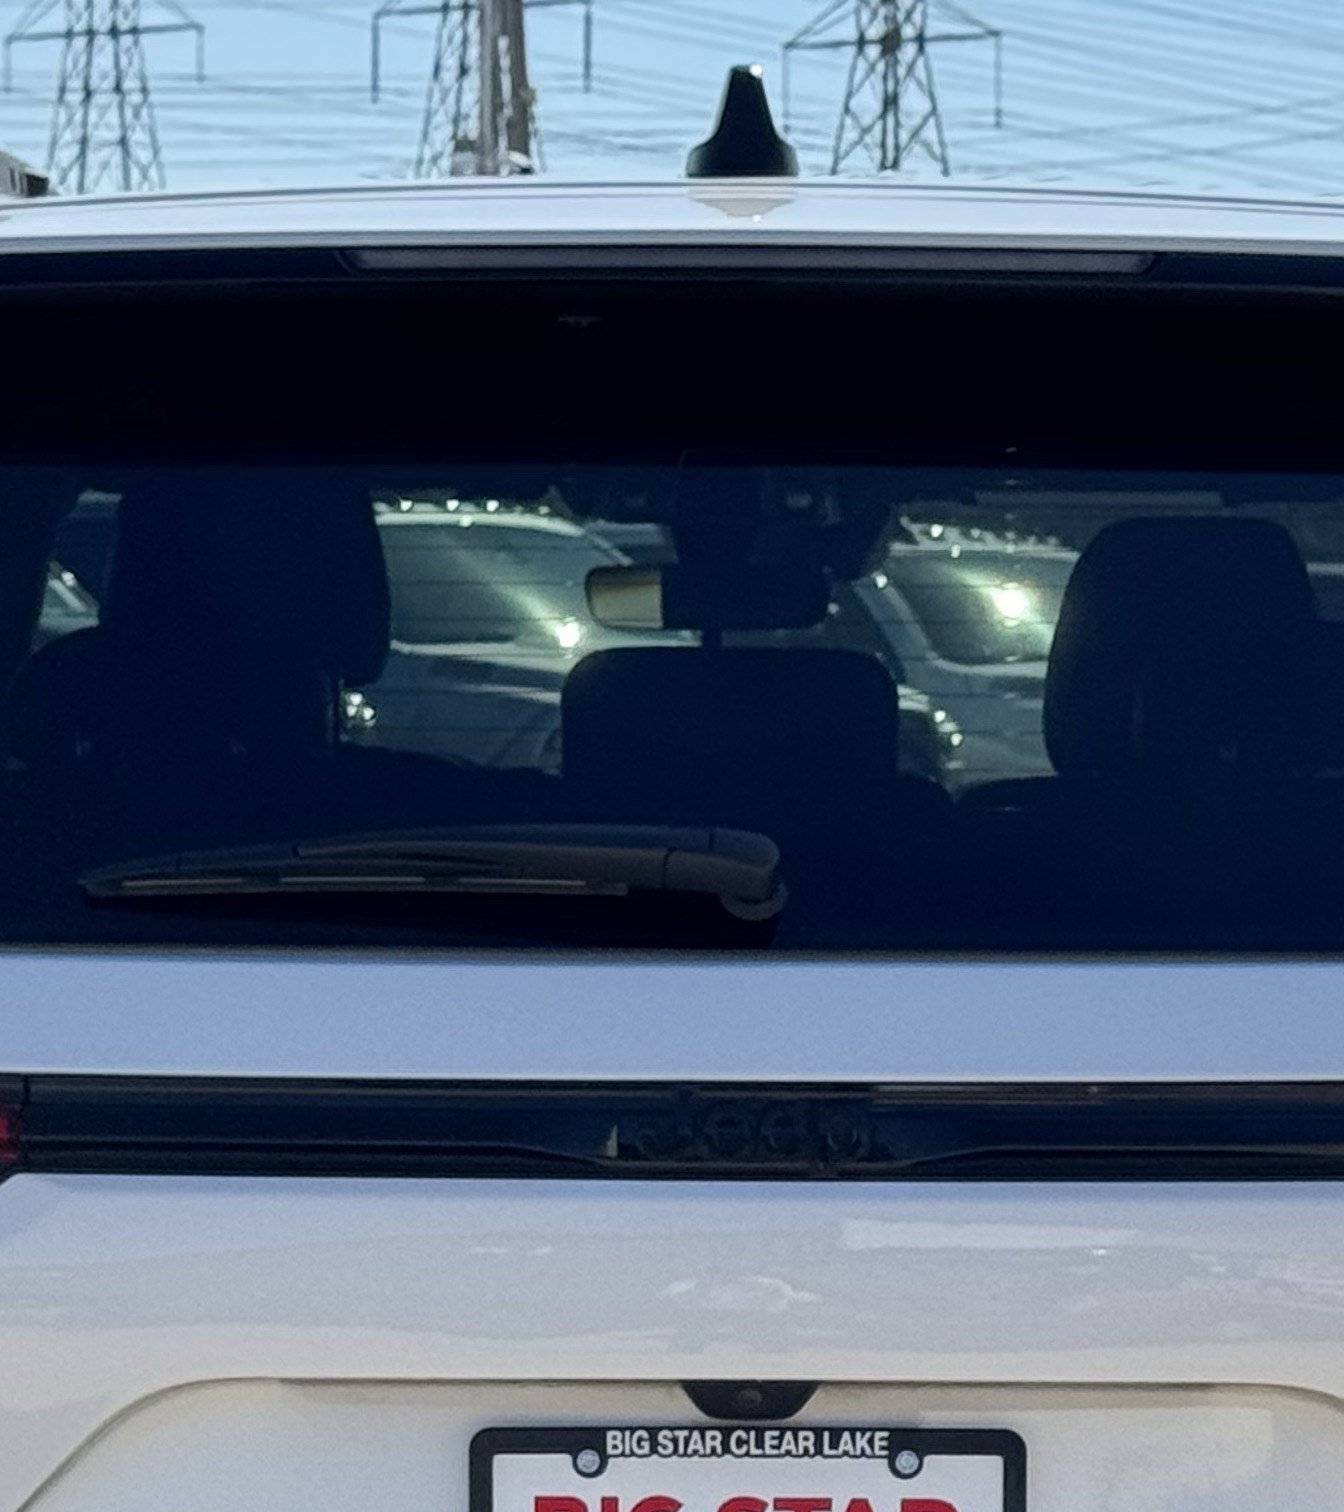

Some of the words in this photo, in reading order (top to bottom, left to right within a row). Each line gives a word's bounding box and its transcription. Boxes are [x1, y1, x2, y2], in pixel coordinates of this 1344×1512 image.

[606, 1430, 649, 1455] BIG
[657, 1430, 723, 1455] STAR
[730, 1430, 815, 1456] CLEAR
[822, 1431, 890, 1456] LAKE
